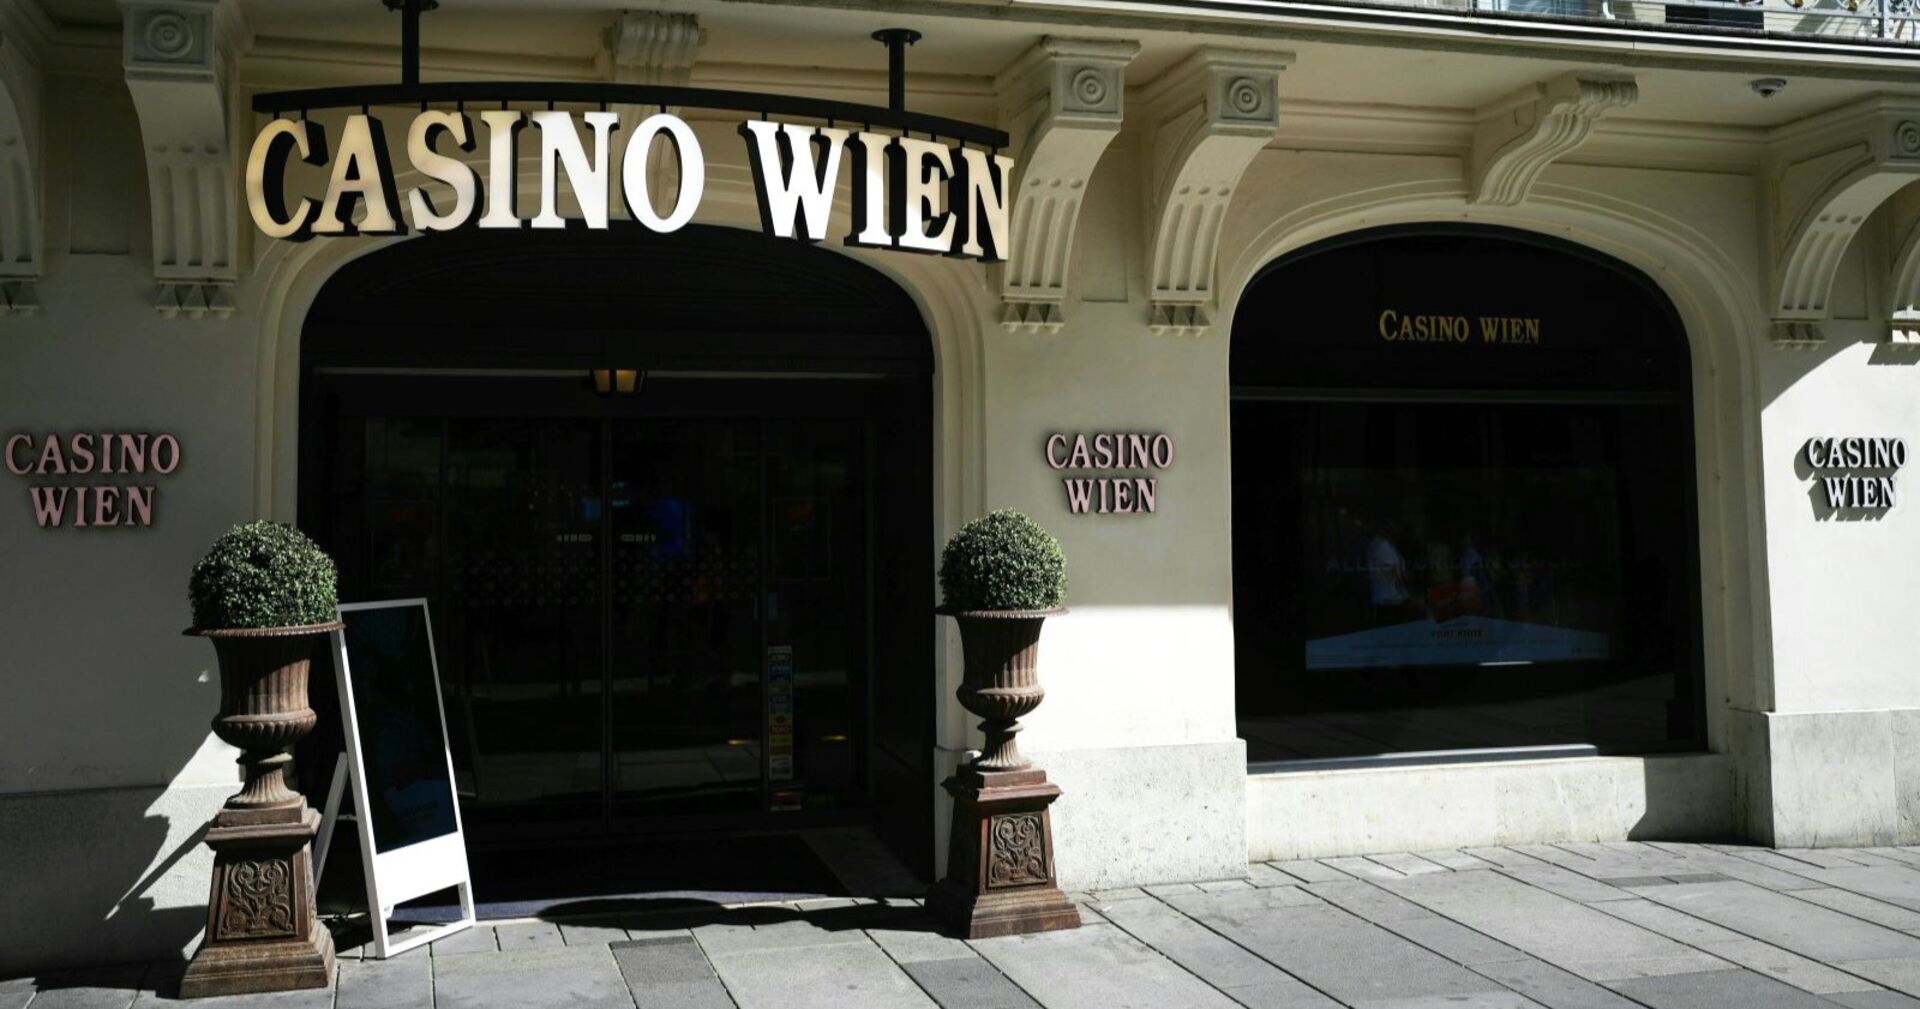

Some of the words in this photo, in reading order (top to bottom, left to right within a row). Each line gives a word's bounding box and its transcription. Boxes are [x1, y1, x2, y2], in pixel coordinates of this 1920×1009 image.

[246, 110, 706, 240] CASINO
[746, 119, 1015, 262] WIEN
[1379, 309, 1470, 342] CASINO
[1479, 317, 1541, 344] WIEN
[5, 433, 181, 475] CASINO
[1046, 433, 1174, 469] CASINO
[1808, 436, 1909, 468] CASINO
[29, 485, 155, 527] WIEN
[1063, 478, 1157, 513] WIEN
[1823, 476, 1898, 508] WIEN
